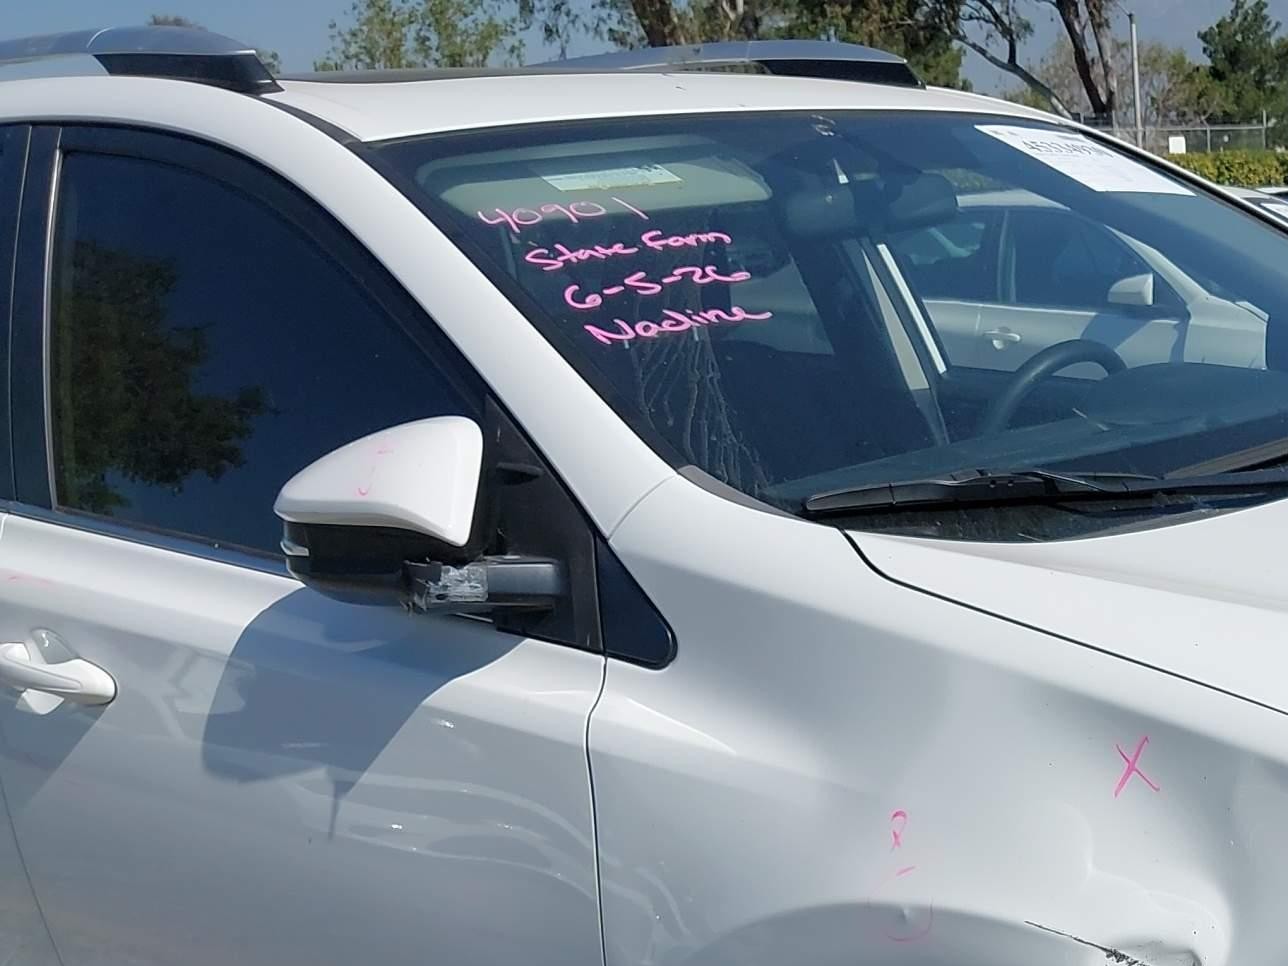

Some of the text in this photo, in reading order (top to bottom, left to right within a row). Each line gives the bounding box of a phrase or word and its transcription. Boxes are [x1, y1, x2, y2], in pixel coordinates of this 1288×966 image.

[641, 230, 732, 251] Farm
[564, 265, 751, 309] 6-5-26
[584, 304, 772, 345] Nadine
